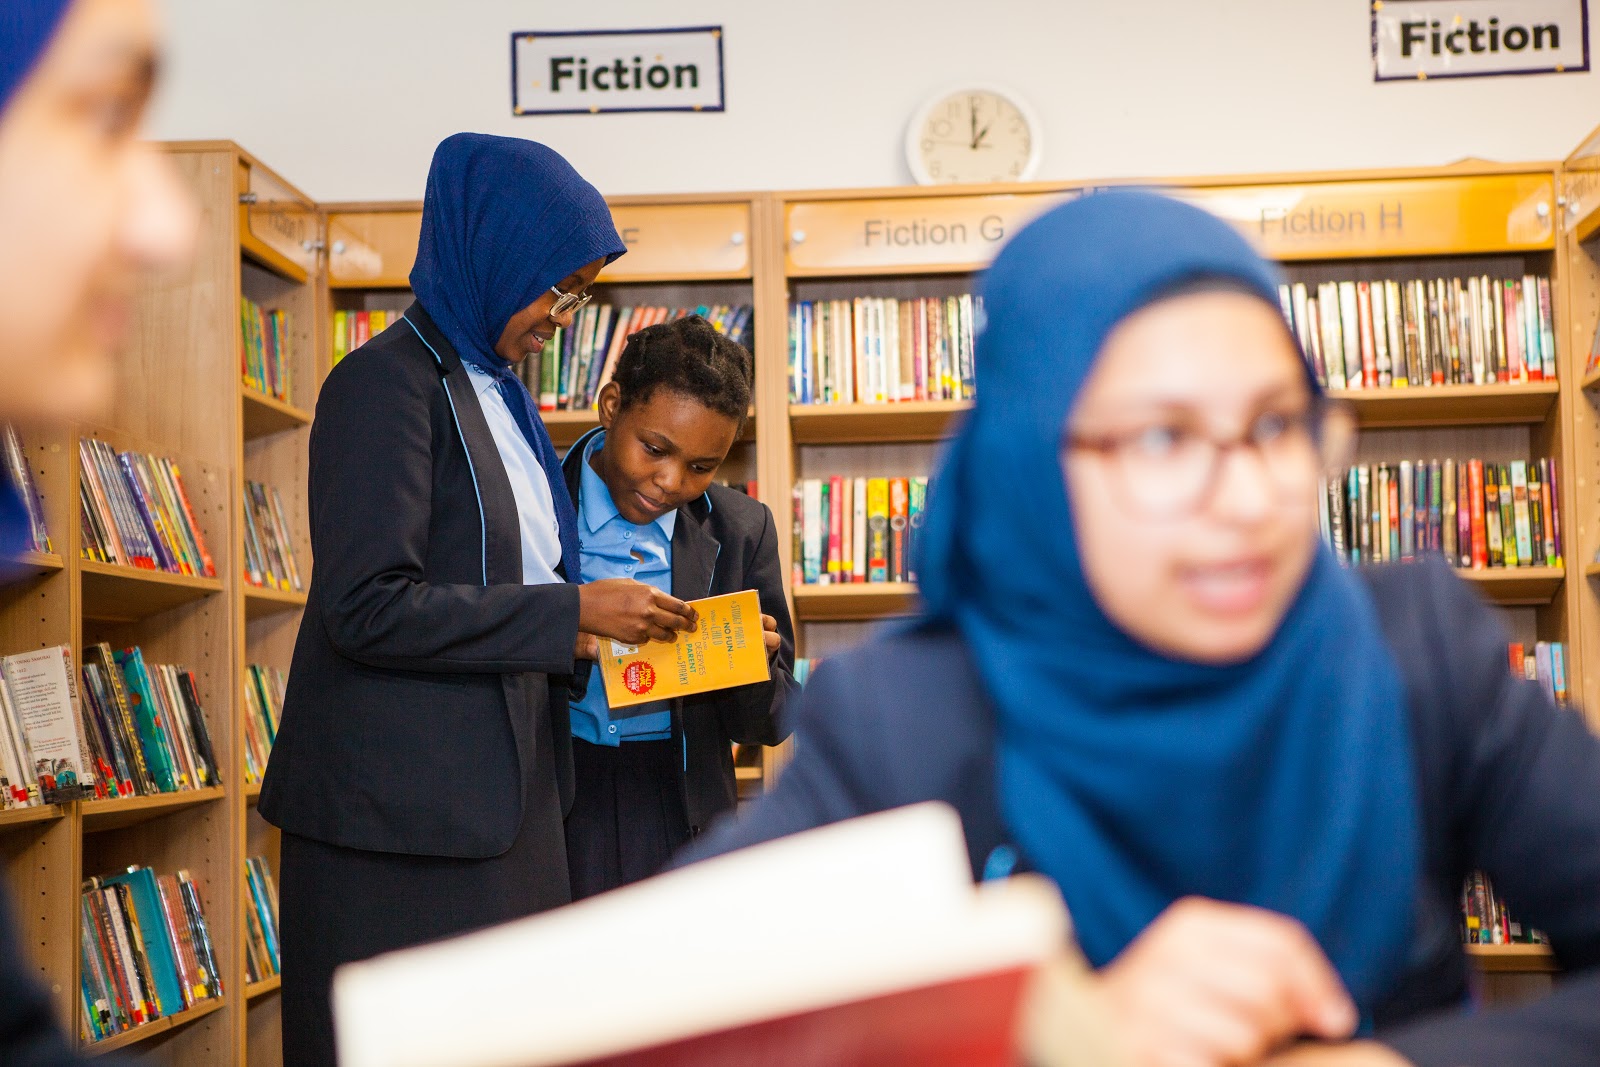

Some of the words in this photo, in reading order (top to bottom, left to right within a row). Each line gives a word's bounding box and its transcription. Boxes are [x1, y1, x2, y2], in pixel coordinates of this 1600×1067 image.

[1400, 17, 1560, 58] Fiction
[549, 55, 700, 92] Fiction
[864, 218, 966, 247] Fiction
[980, 214, 1004, 242] G
[1259, 205, 1367, 235] Fiction
[1380, 200, 1404, 230] H
[700, 618, 709, 640] WANTS
[711, 626, 724, 646] CHILD
[724, 622, 732, 634] NO
[686, 644, 696, 673] PARENT
[695, 642, 706, 676] DESERVES
[726, 636, 734, 652] FUN
[64, 656, 76, 698] SAMURAI
[677, 661, 689, 686] SPARKY
